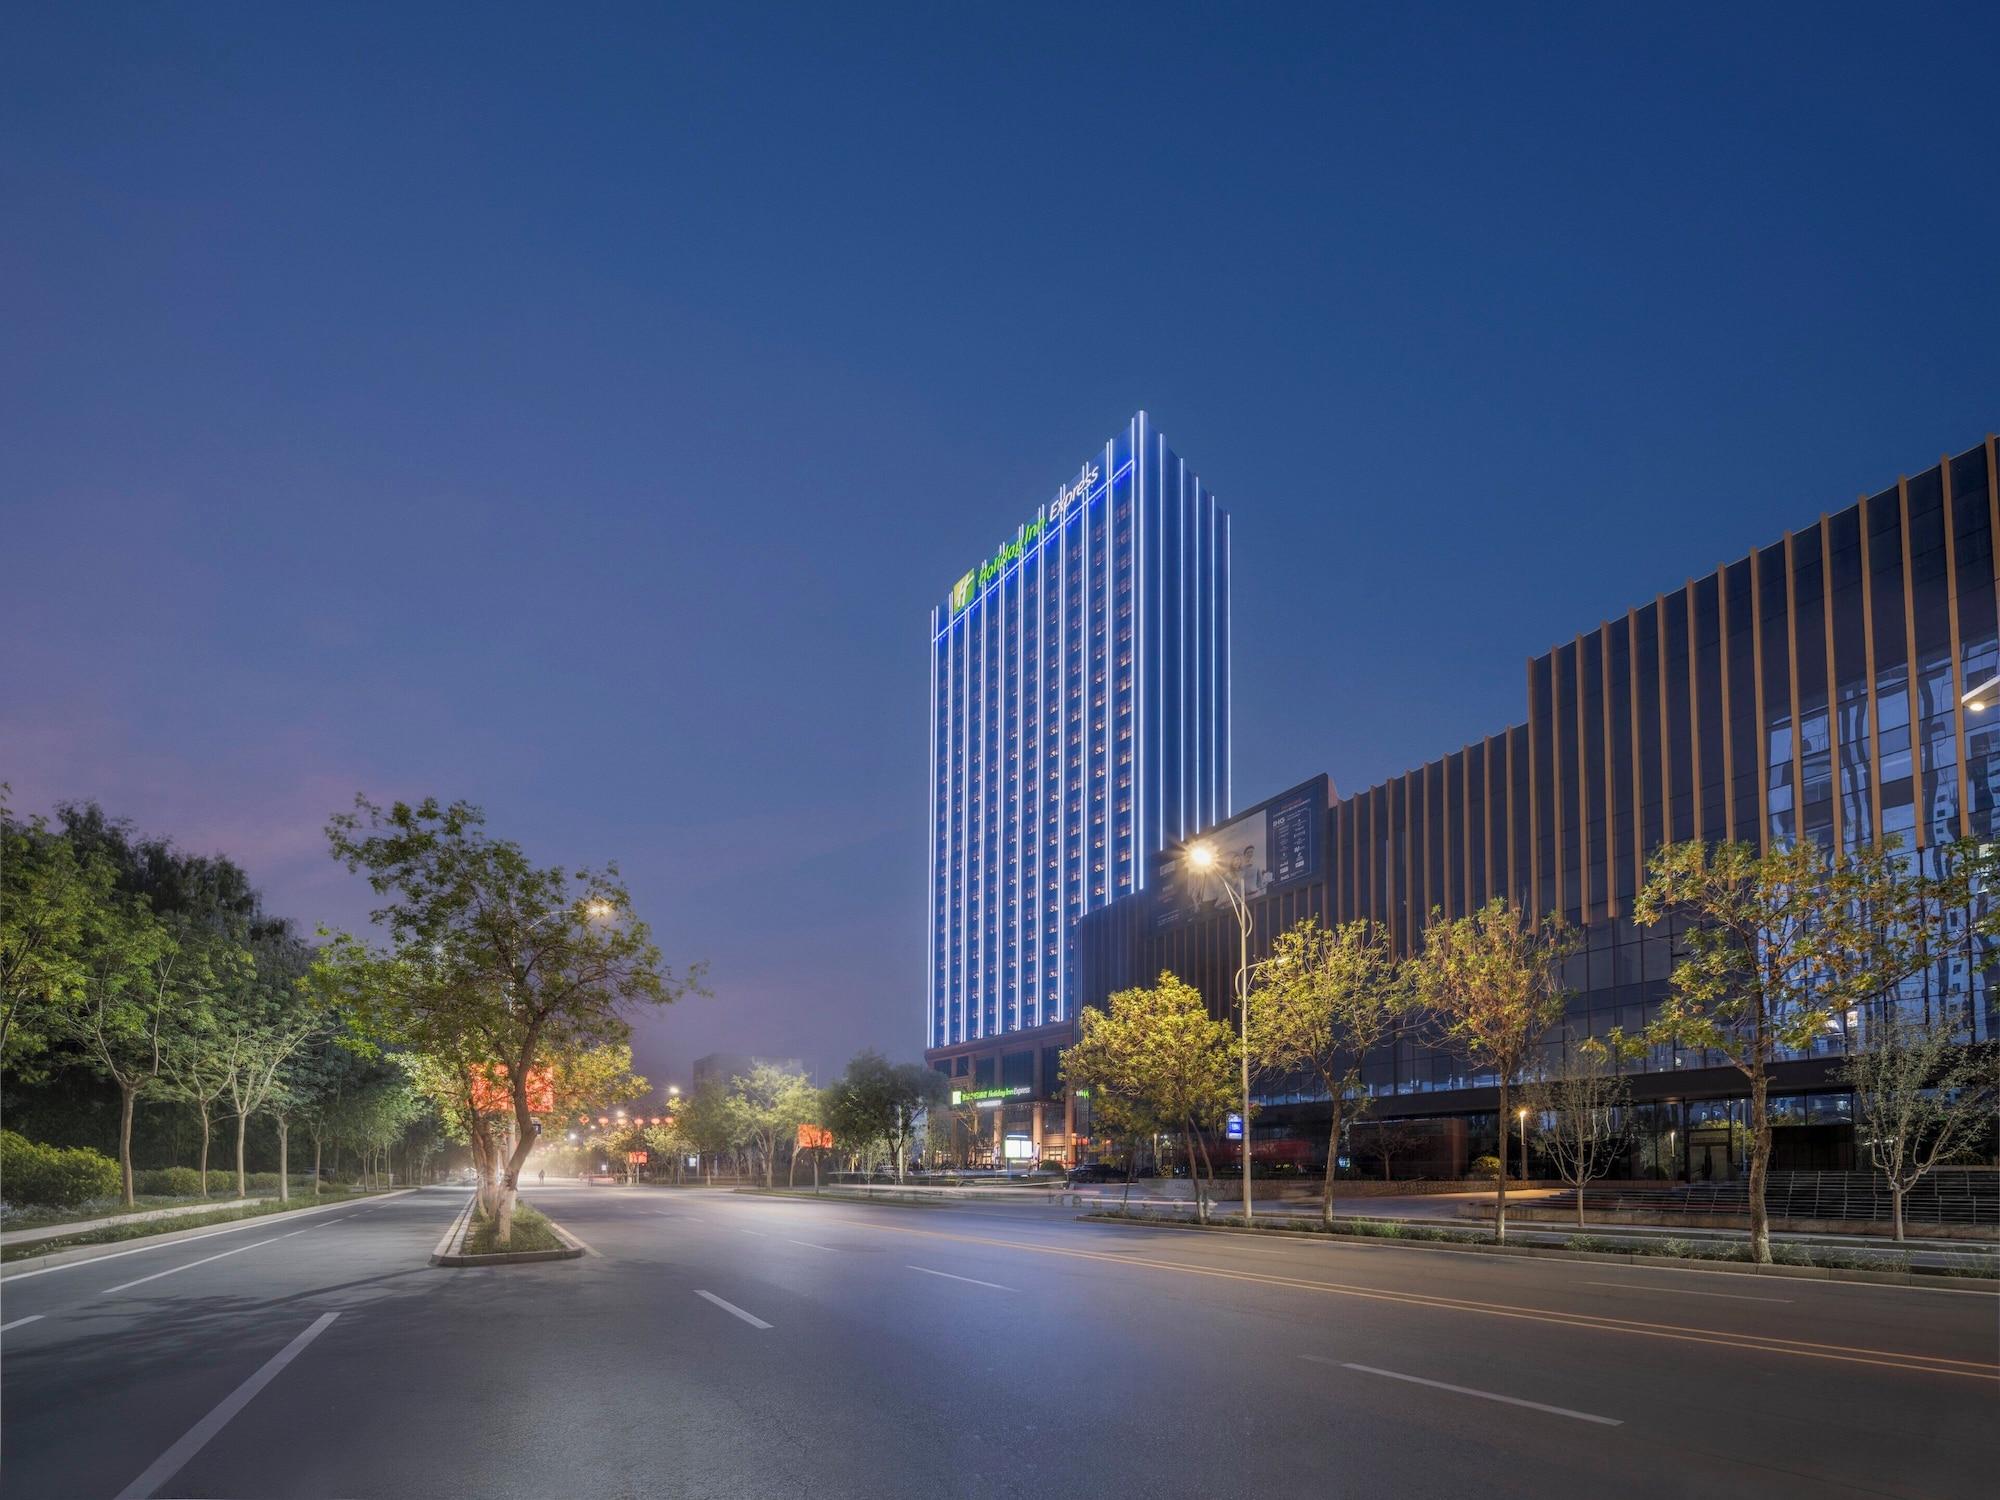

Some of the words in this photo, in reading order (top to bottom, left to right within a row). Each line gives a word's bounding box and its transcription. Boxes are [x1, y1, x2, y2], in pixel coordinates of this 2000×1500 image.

[978, 539, 1024, 587] Holiday
[1024, 516, 1046, 545] Inn
[1049, 466, 1099, 522] Express
[988, 1089, 1006, 1098] Holiday
[1006, 1087, 1014, 1096] Inn
[1014, 1087, 1031, 1096] Express
